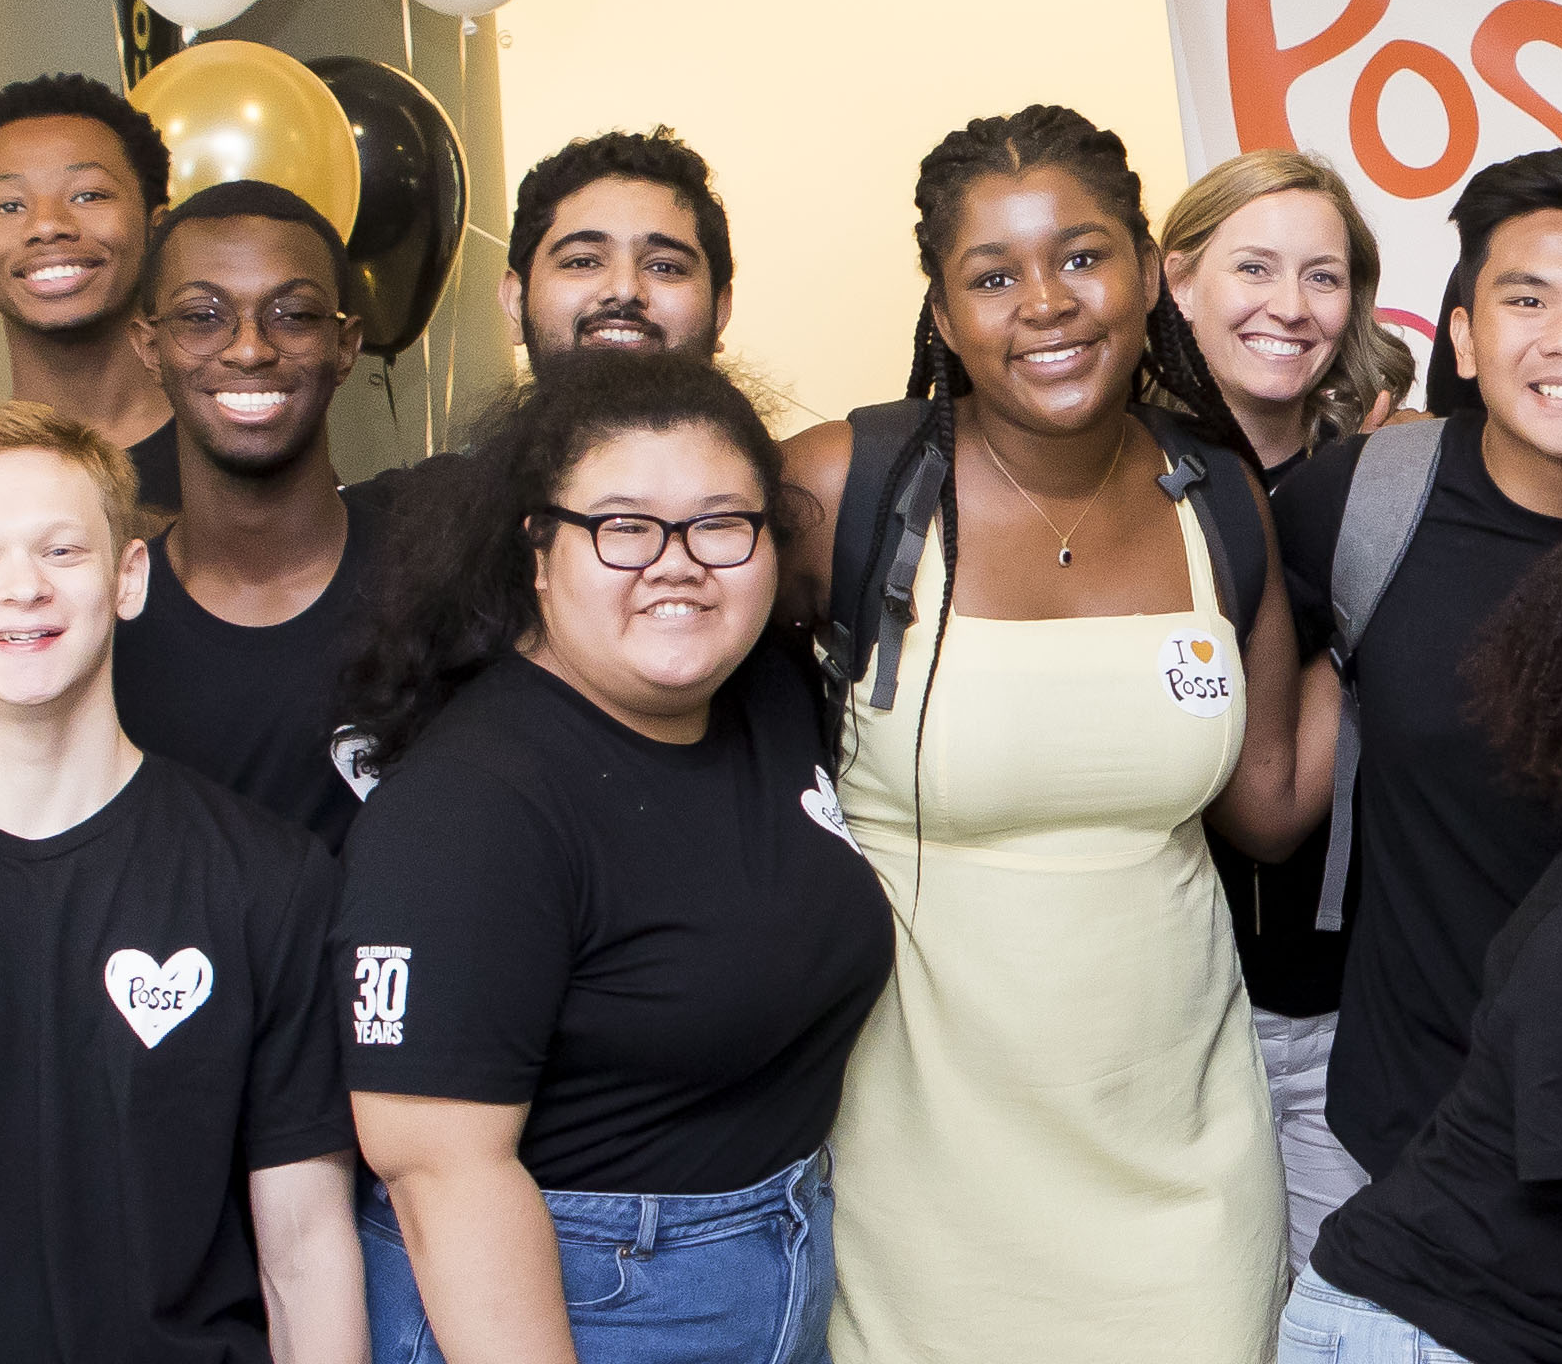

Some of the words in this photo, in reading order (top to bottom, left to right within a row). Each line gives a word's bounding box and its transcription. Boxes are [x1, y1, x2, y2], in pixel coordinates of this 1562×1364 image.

[1172, 639, 1189, 665] I
[128, 976, 187, 1010] POSSE
[353, 957, 409, 1022] 30
[353, 1020, 405, 1045] YEARS
